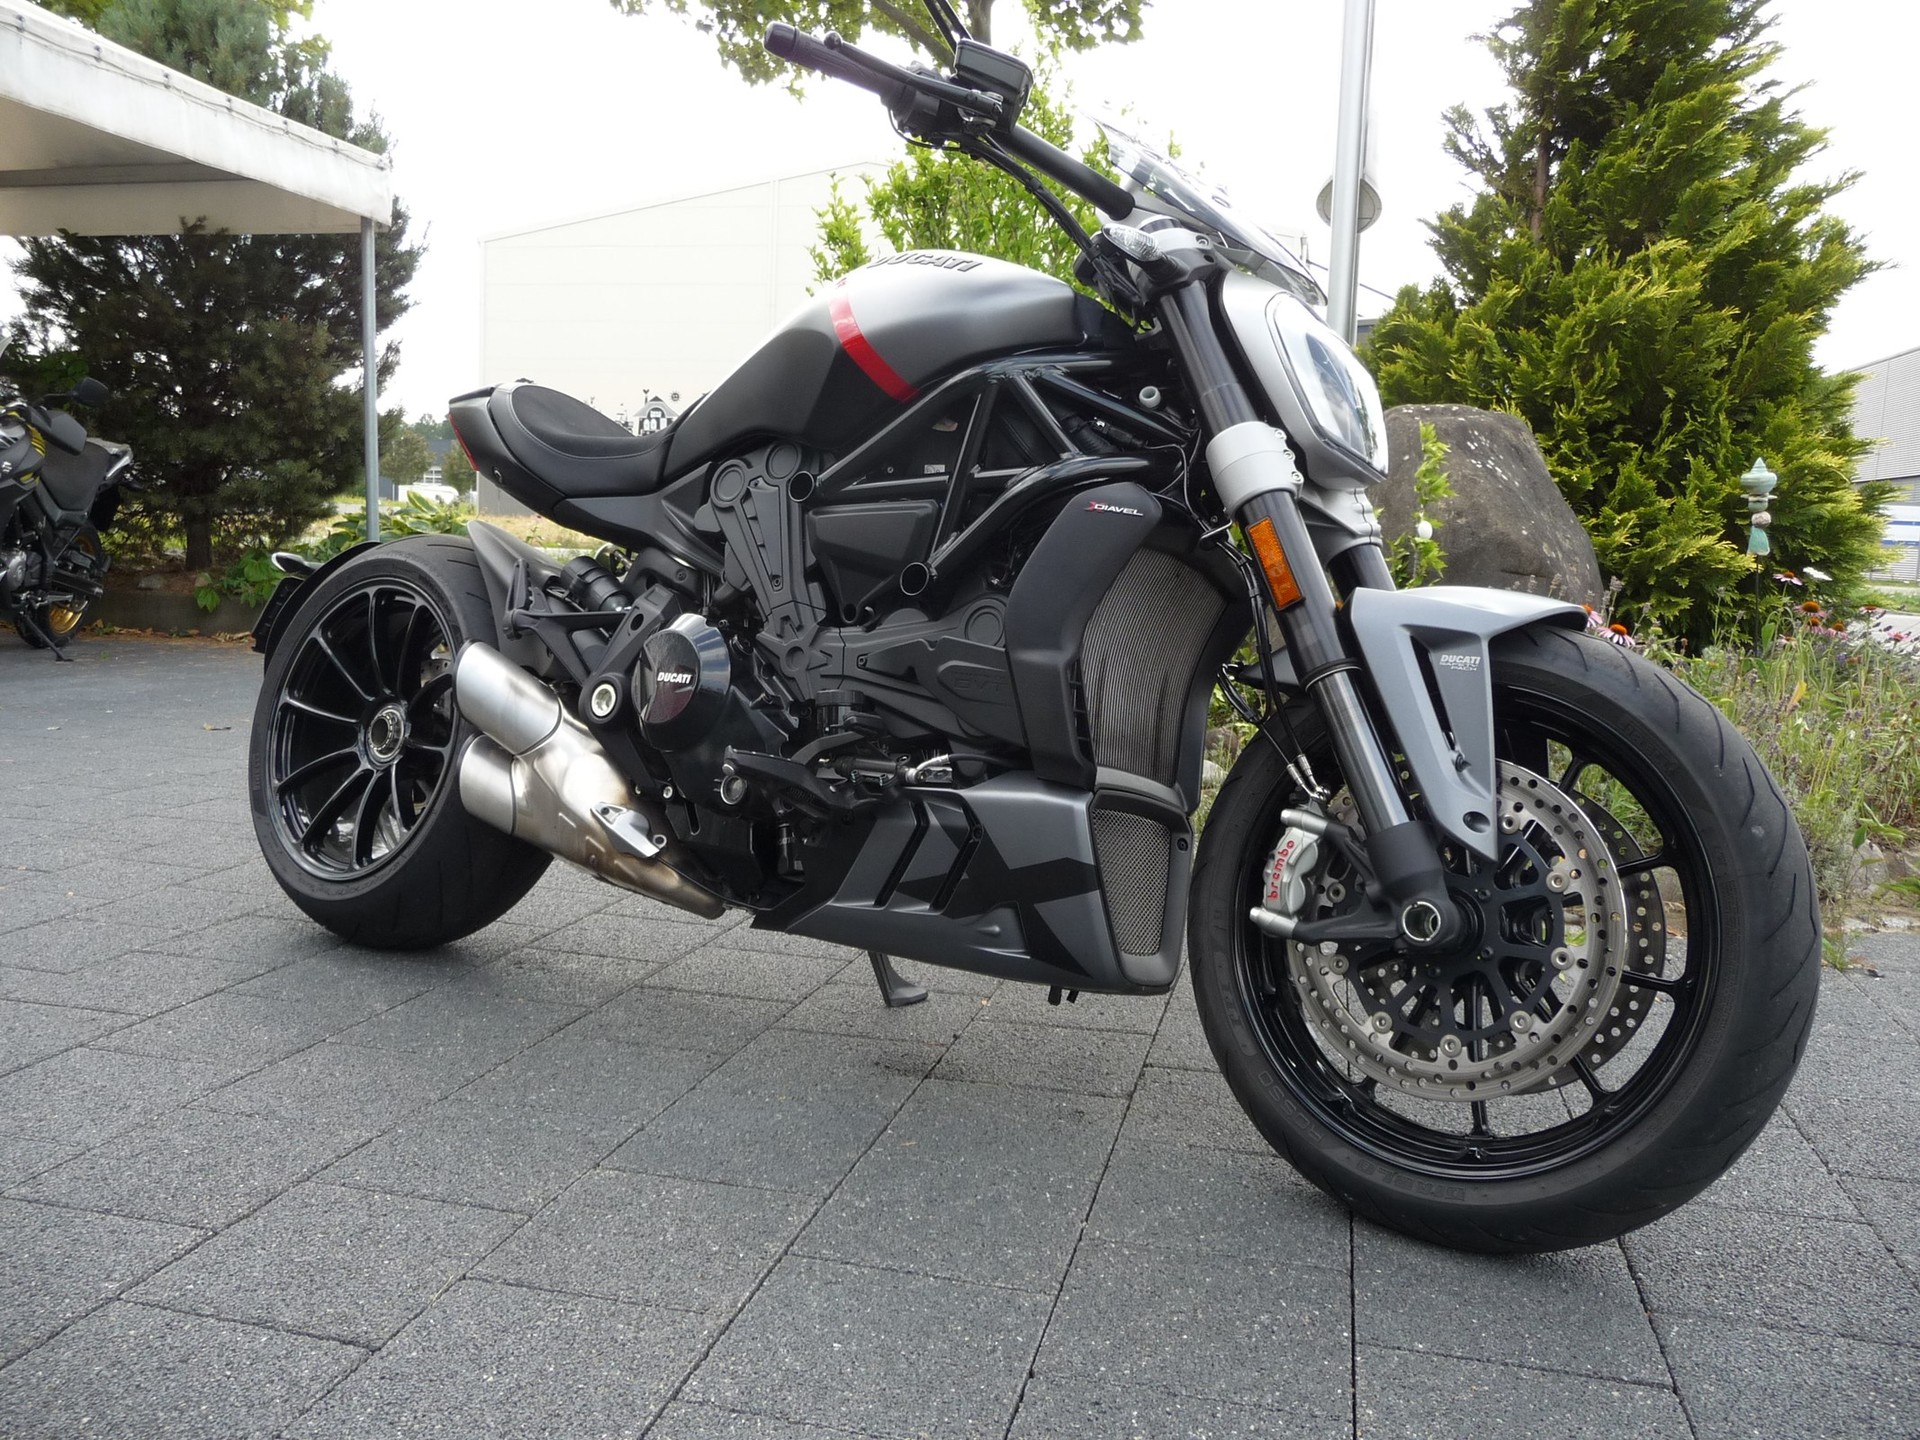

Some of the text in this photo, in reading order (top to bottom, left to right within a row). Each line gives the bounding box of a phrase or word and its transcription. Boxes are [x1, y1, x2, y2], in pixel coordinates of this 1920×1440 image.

[1440, 654, 1481, 664] DUCATI
[657, 671, 692, 684] DUCATI
[1267, 840, 1295, 900] brembo
[1257, 1070, 1326, 1143] ROSSO
